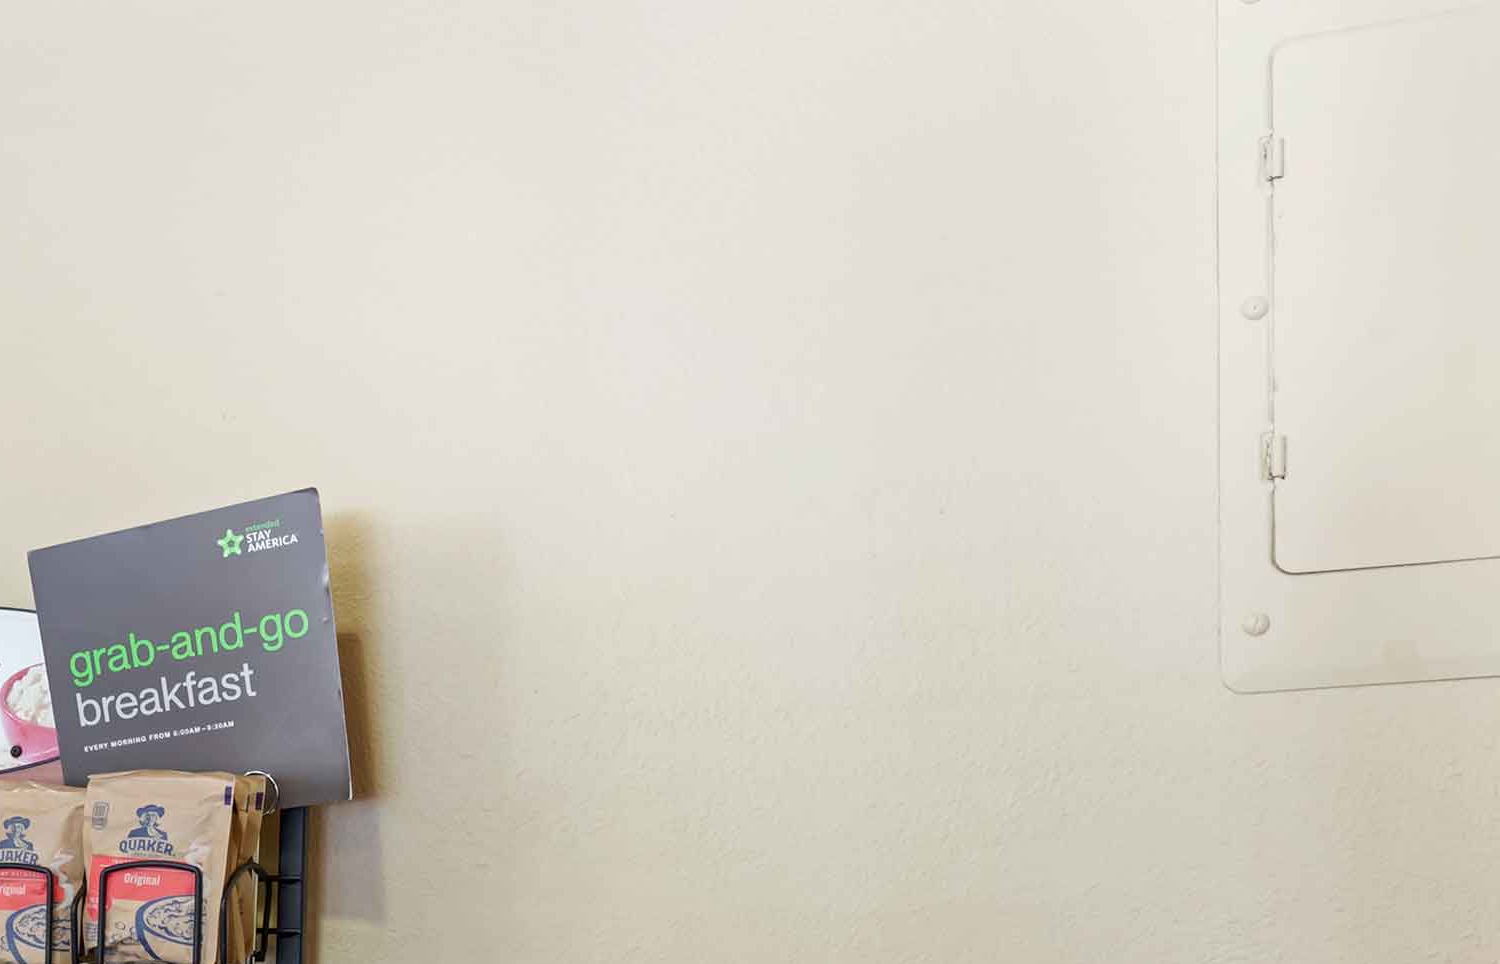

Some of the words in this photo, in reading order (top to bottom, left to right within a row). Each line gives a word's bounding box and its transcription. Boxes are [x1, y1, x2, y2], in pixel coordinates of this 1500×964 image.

[246, 529, 271, 544] STAY
[248, 534, 298, 553] AMERICA
[69, 608, 309, 687] grab-and-go
[76, 663, 258, 727] breakfast
[84, 743, 108, 753] EVERY
[110, 735, 147, 748] MORNING
[149, 731, 171, 742] FROM
[119, 839, 174, 855] QUAKER
[124, 872, 161, 887] Original
